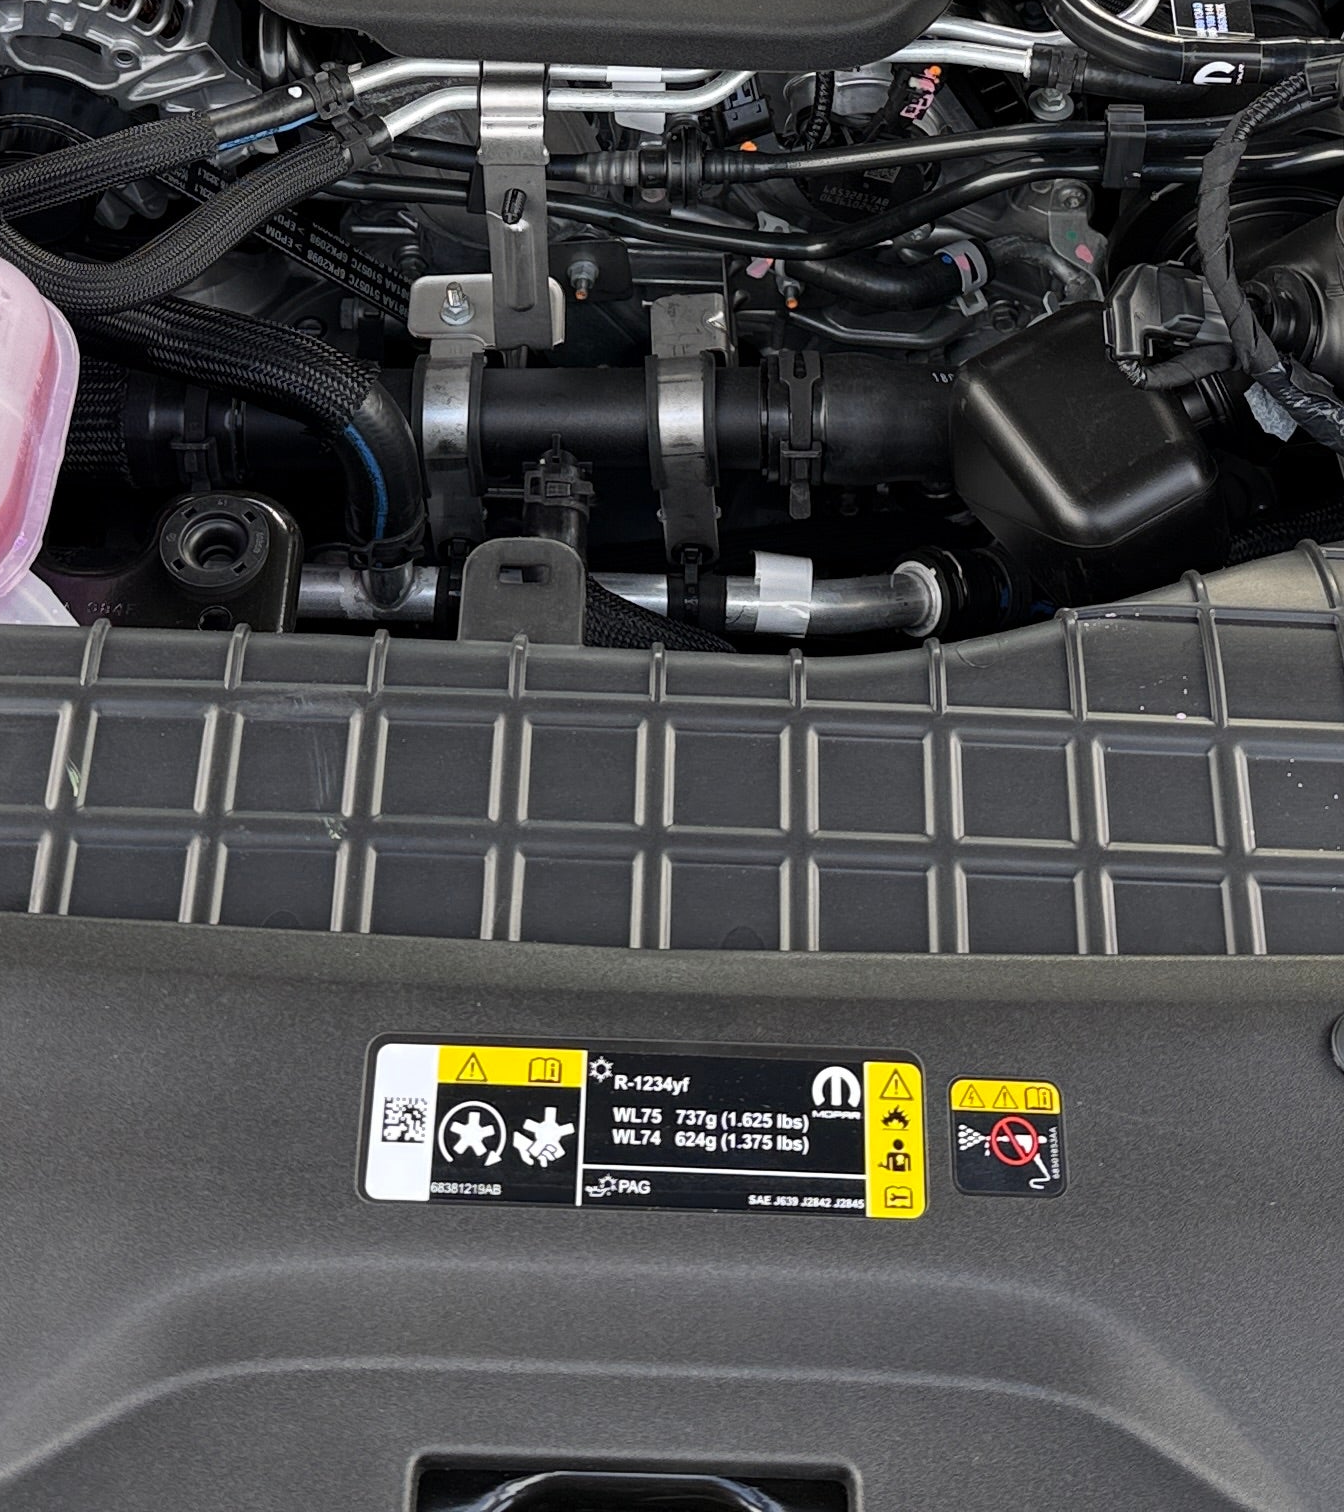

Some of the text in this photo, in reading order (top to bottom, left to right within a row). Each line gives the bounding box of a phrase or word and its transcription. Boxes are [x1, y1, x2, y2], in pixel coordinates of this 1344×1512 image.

[265, 225, 293, 249] EPDM
[307, 250, 346, 279] 6PK2098
[614, 1074, 691, 1095] R-1234yf
[612, 1106, 810, 1132] WL75 737g (1.625 lbs)
[812, 1109, 862, 1120] MOPAR
[612, 1128, 810, 1155] WL74 624g (1.375 lbs)
[618, 1179, 652, 1194] PAG
[748, 1194, 772, 1206] SAE
